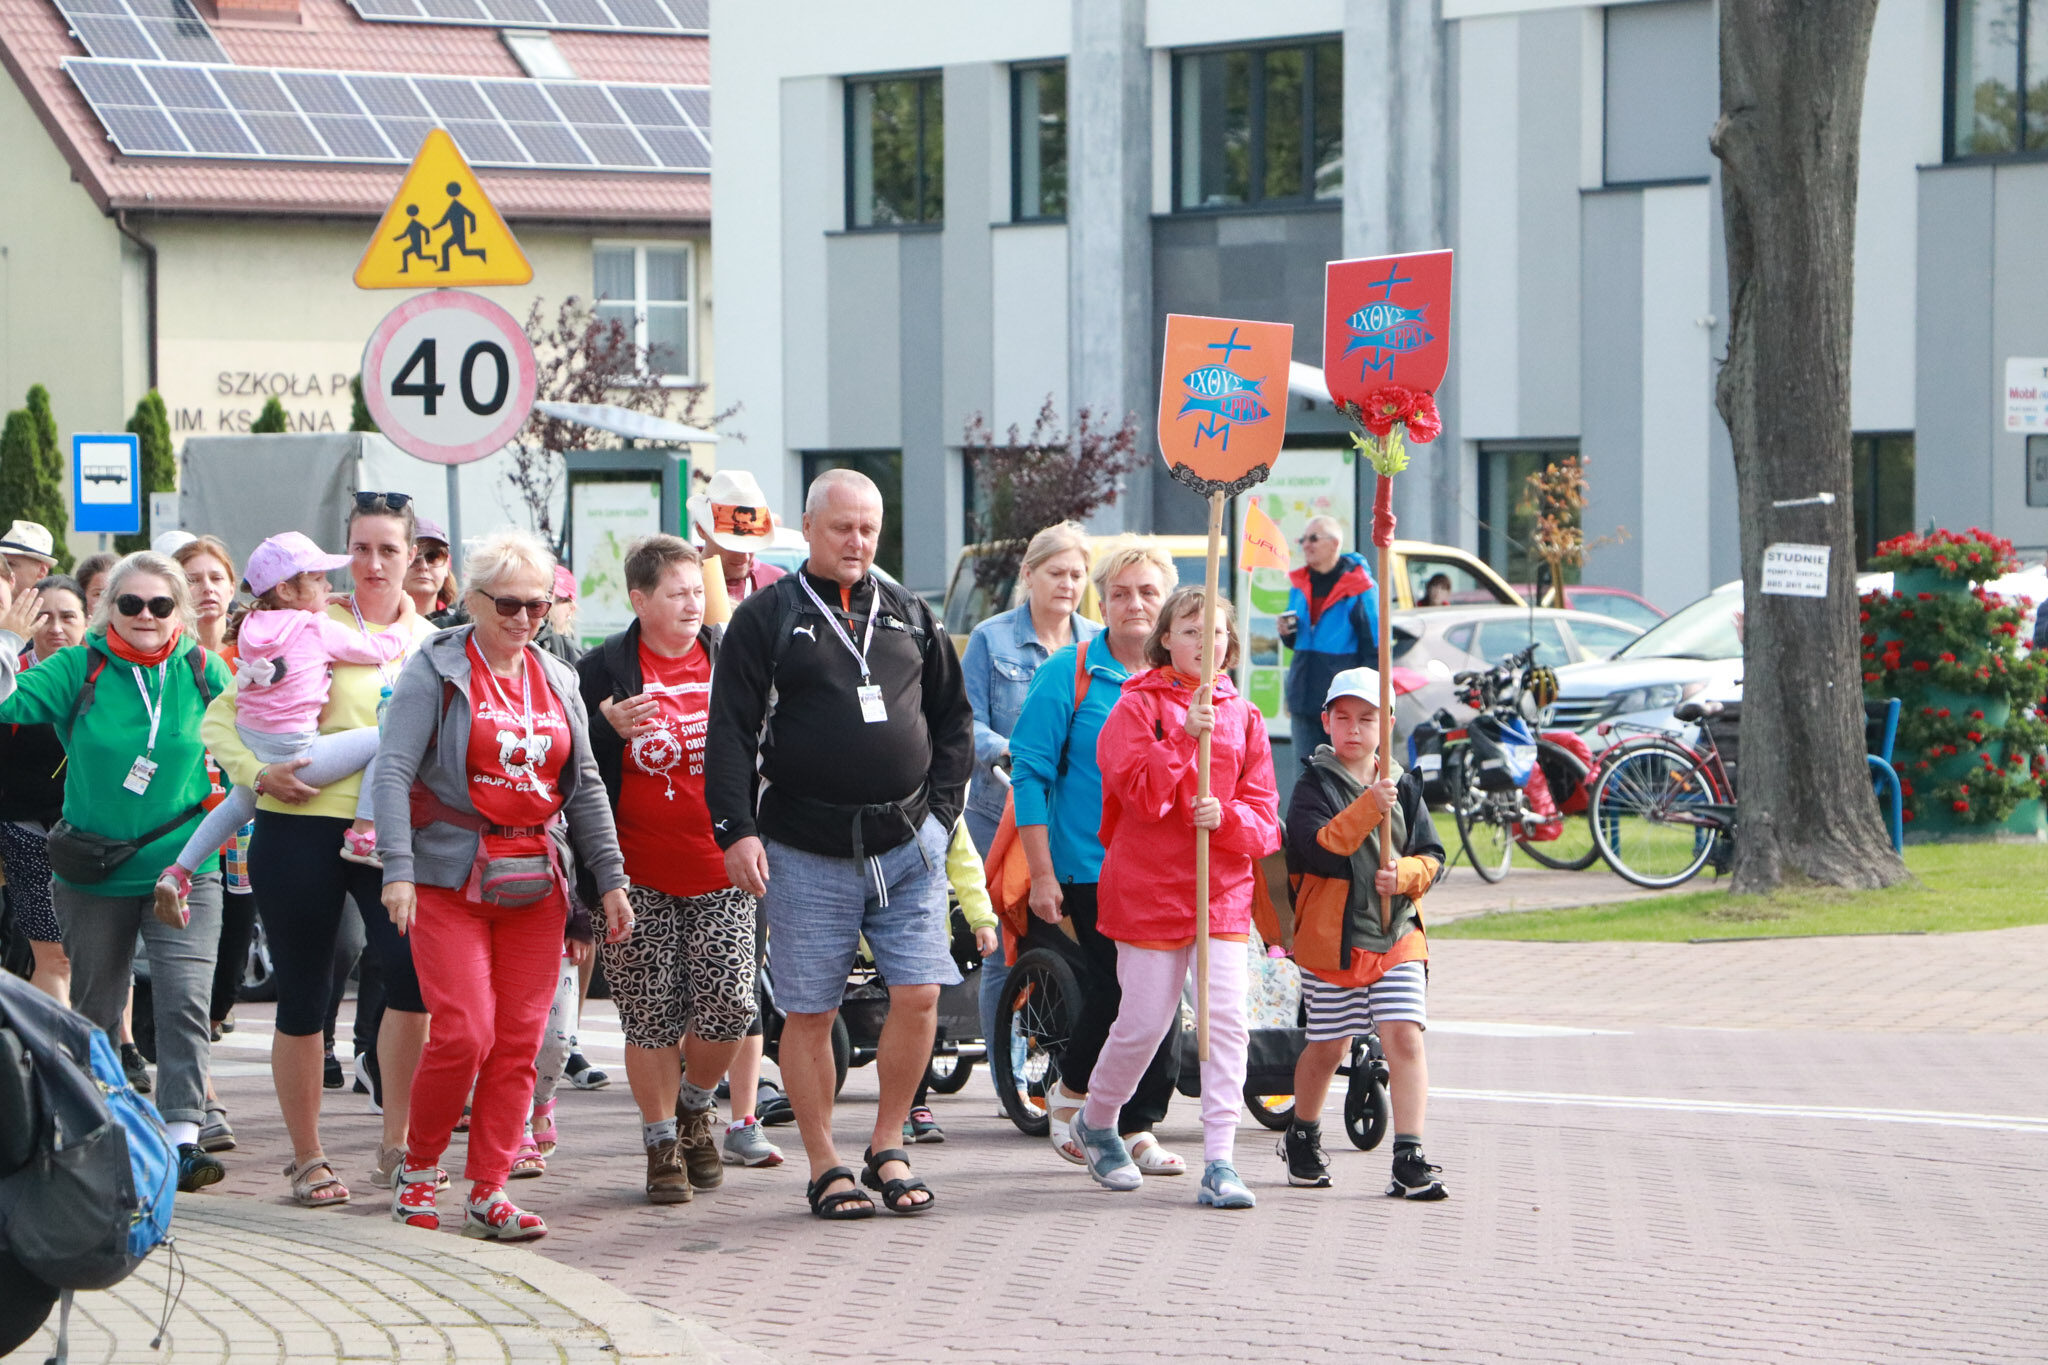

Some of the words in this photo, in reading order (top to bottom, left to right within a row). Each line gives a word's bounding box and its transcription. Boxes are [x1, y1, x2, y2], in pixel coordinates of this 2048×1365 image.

[217, 371, 323, 397] SZKOŁA
[391, 338, 509, 415] 40
[174, 408, 207, 431] IM.
[284, 410, 335, 432] ANA
[1767, 551, 1825, 565] STUDNIE
[681, 720, 709, 737] ŚWIĘT
[685, 736, 707, 750] OBU
[688, 751, 705, 763] MN
[689, 764, 703, 776] DO
[473, 774, 513, 789] GRUPA
